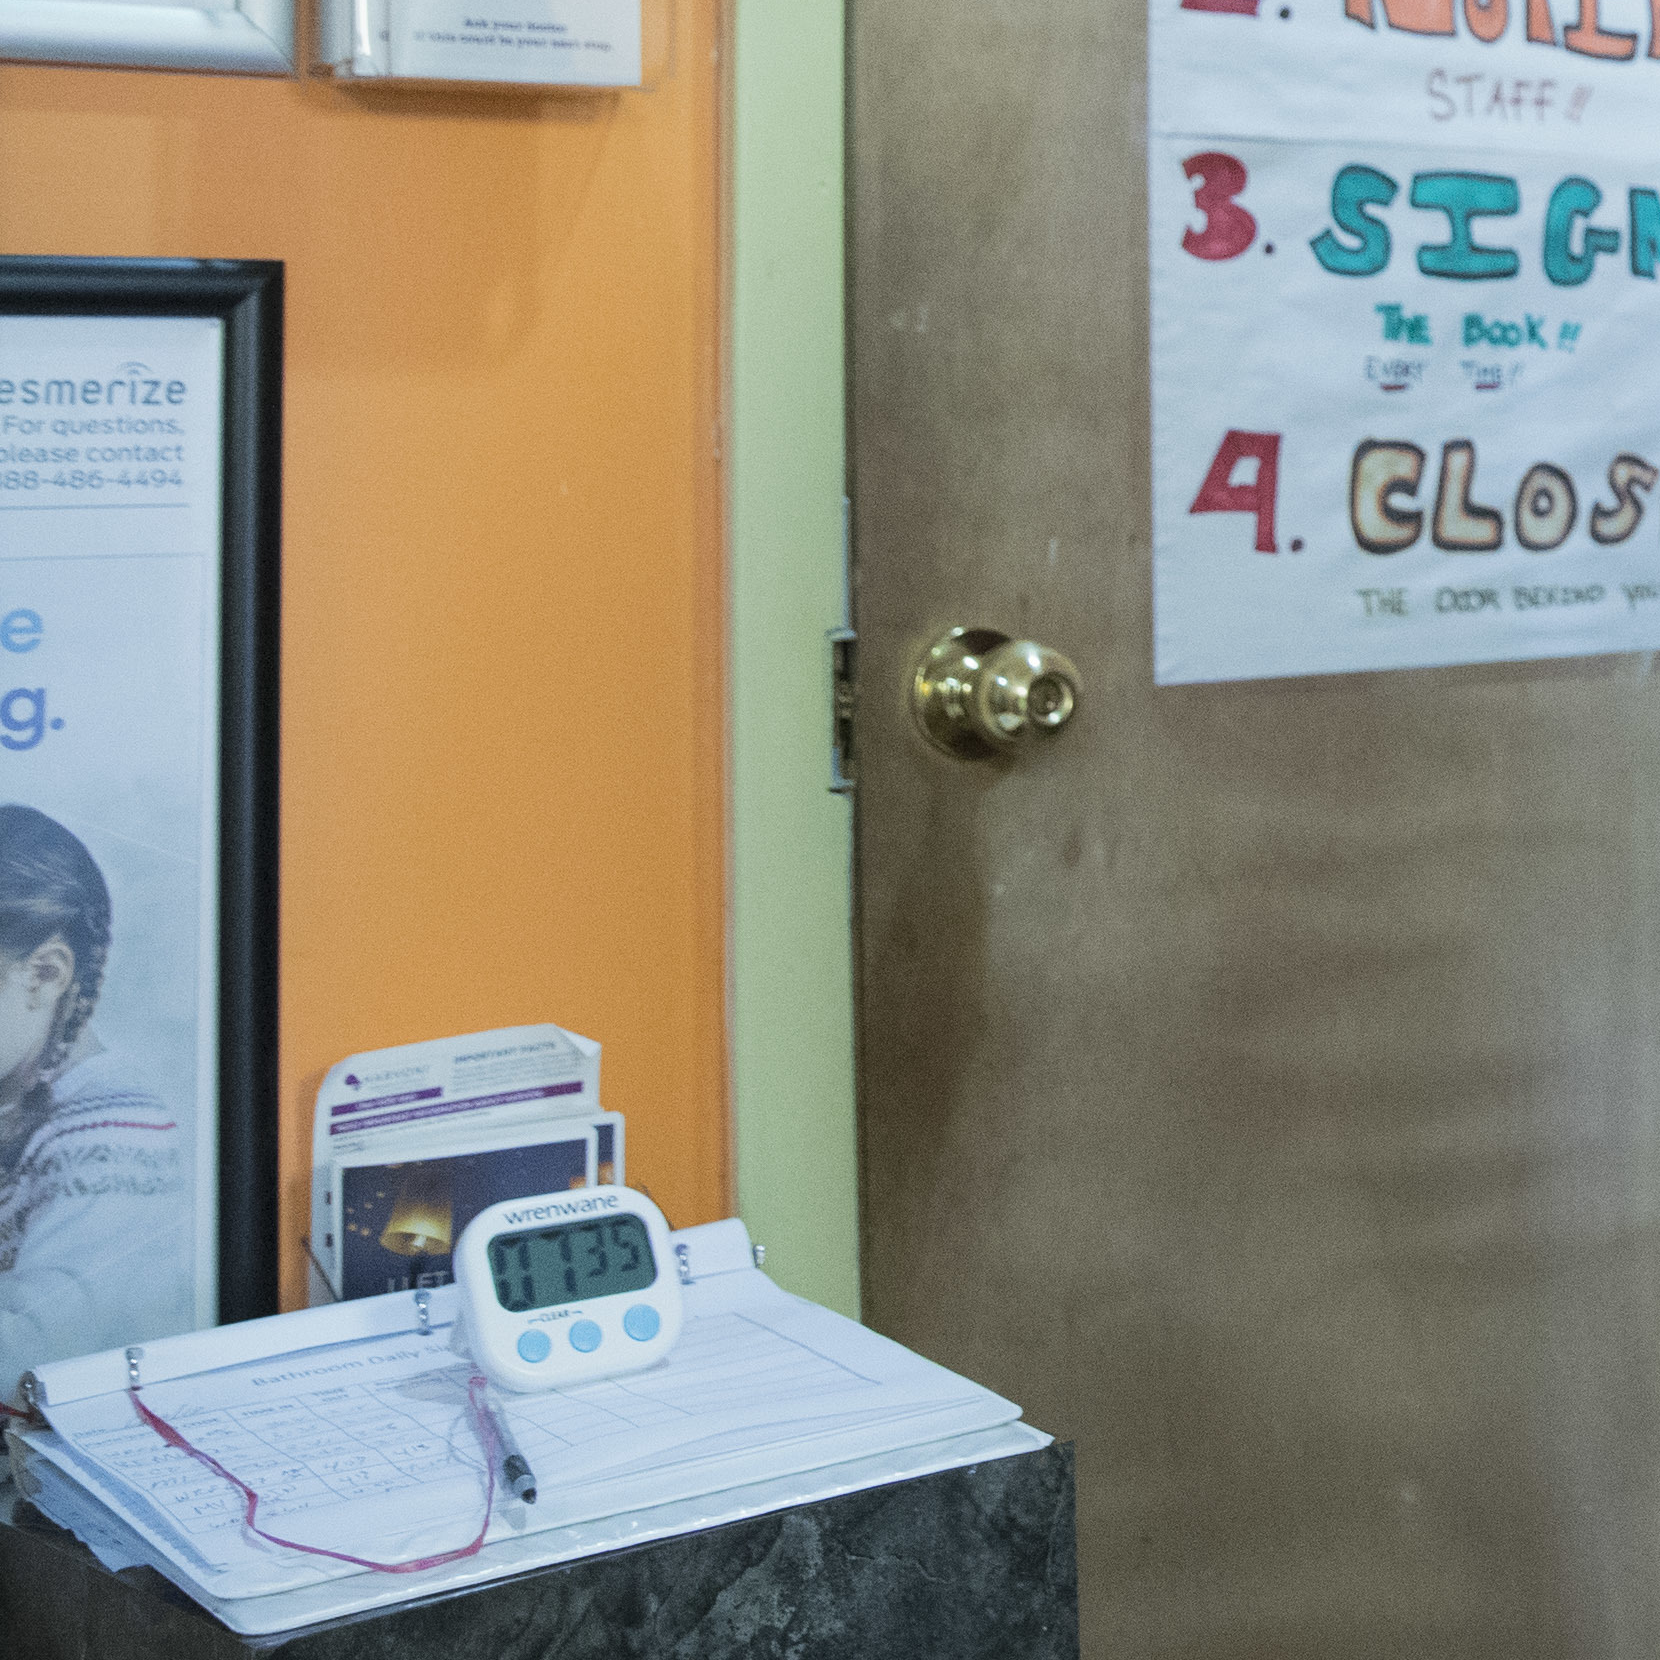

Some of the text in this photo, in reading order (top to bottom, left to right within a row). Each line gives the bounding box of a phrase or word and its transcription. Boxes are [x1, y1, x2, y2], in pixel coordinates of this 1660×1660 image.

[2, 415, 45, 435] For
[85, 444, 183, 464] contact
[1355, 588, 1410, 617] THE
[503, 1194, 620, 1226] wrenwane
[252, 1360, 363, 1386] Bathroom
